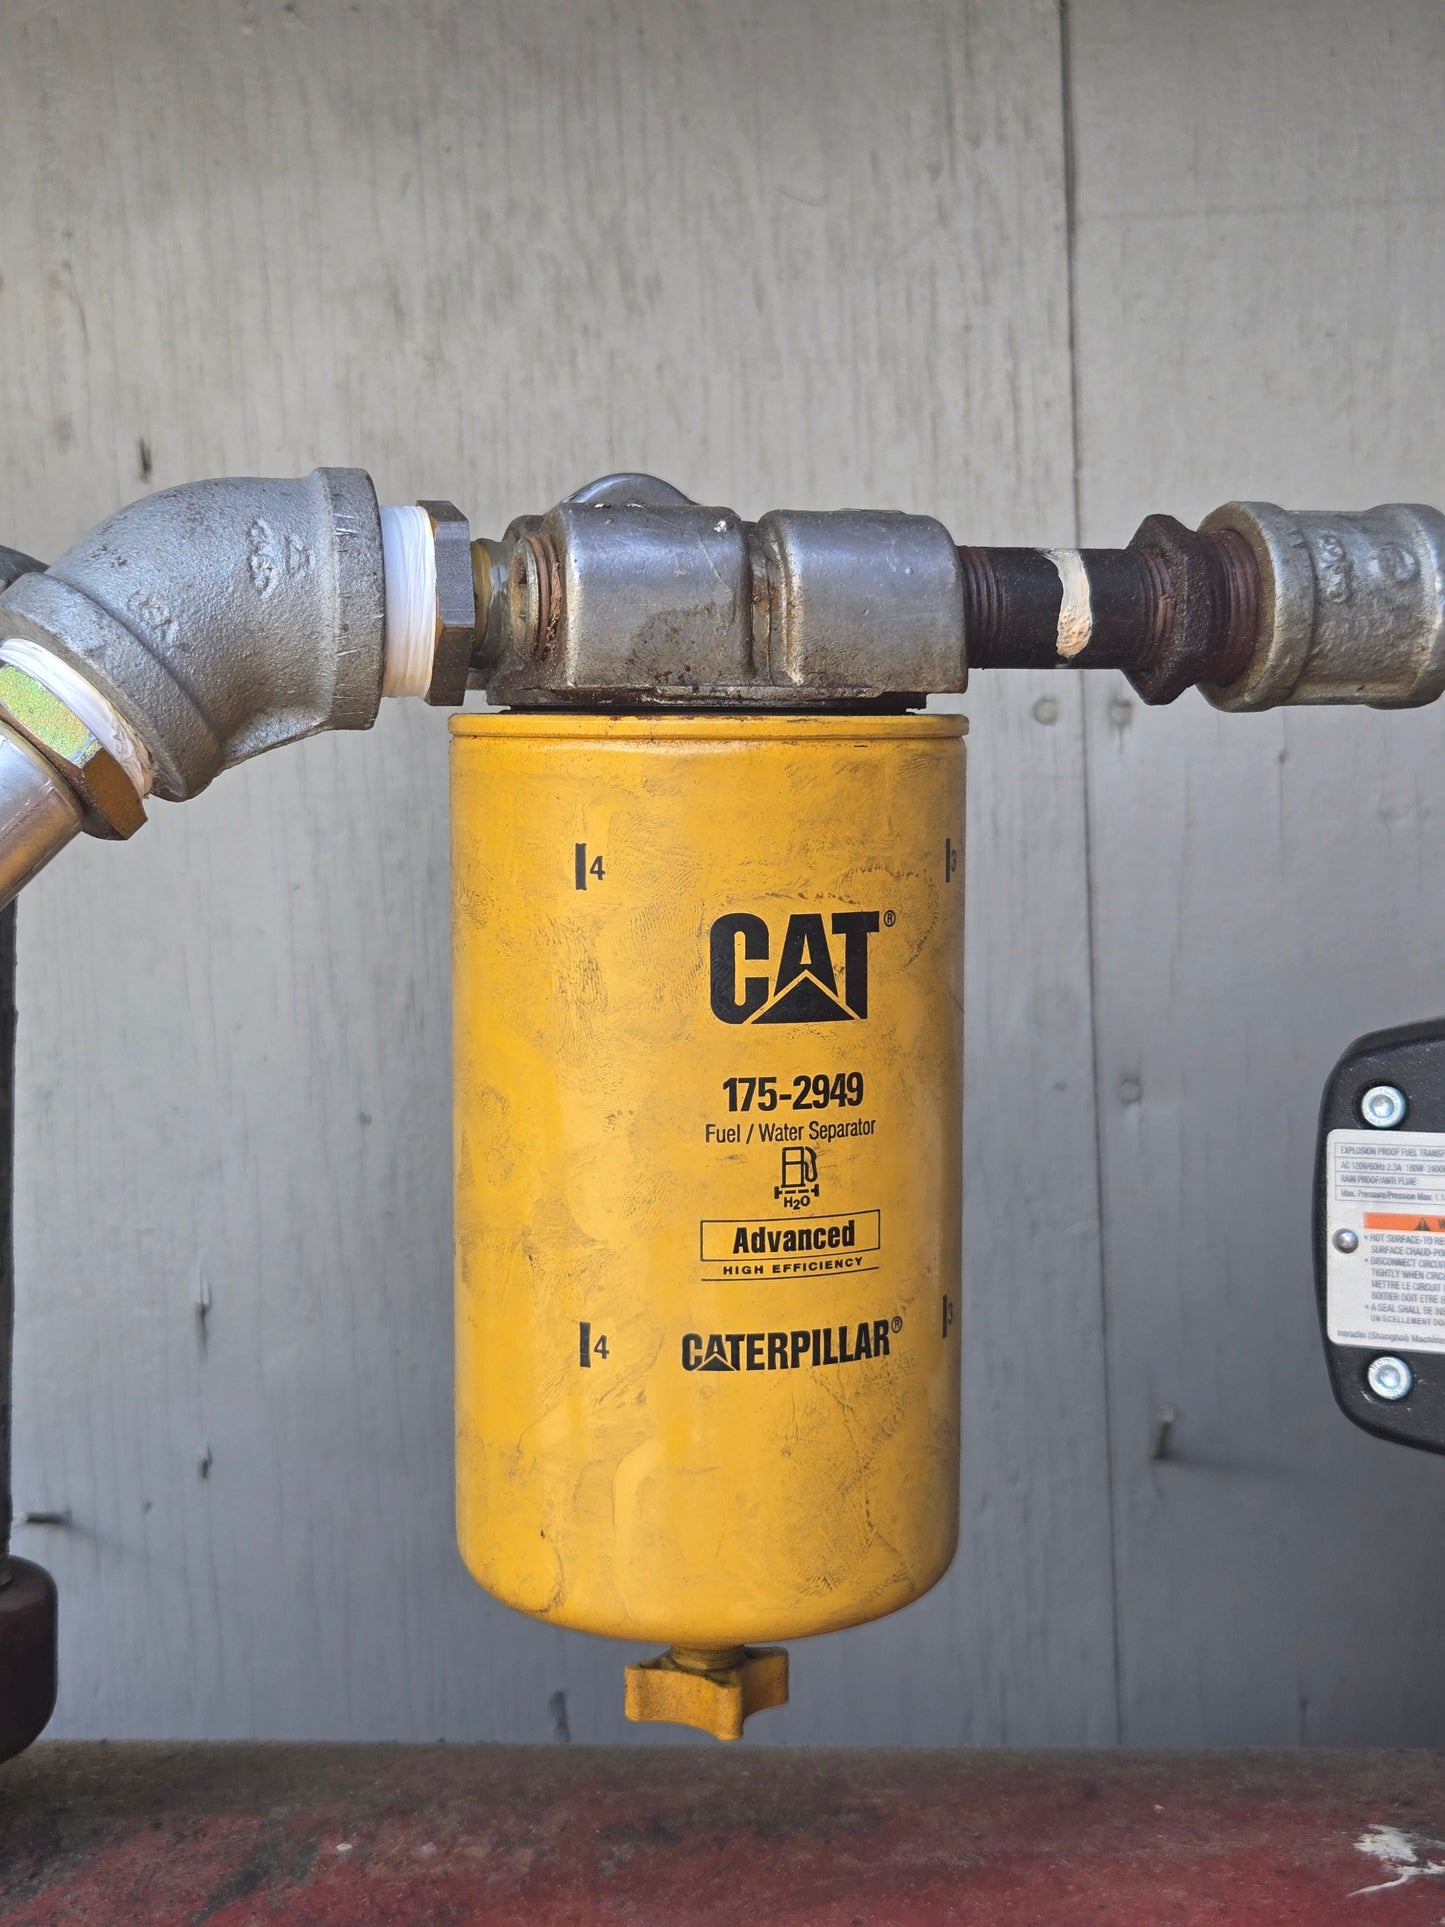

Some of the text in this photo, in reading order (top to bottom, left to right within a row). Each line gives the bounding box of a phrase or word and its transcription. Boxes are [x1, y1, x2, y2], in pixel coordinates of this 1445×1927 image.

[722, 1072, 864, 1112] 175-2949
[705, 1118, 877, 1145] Fuel / Water Separator
[1377, 1147, 1400, 1157] PROOF
[1401, 1148, 1418, 1157] FUEL
[732, 1220, 855, 1255] Advanced
[1370, 1233, 1385, 1243] HOT
[1370, 1245, 1404, 1255] SURFACE
[723, 1256, 863, 1275] HIGH EFFICIENCY
